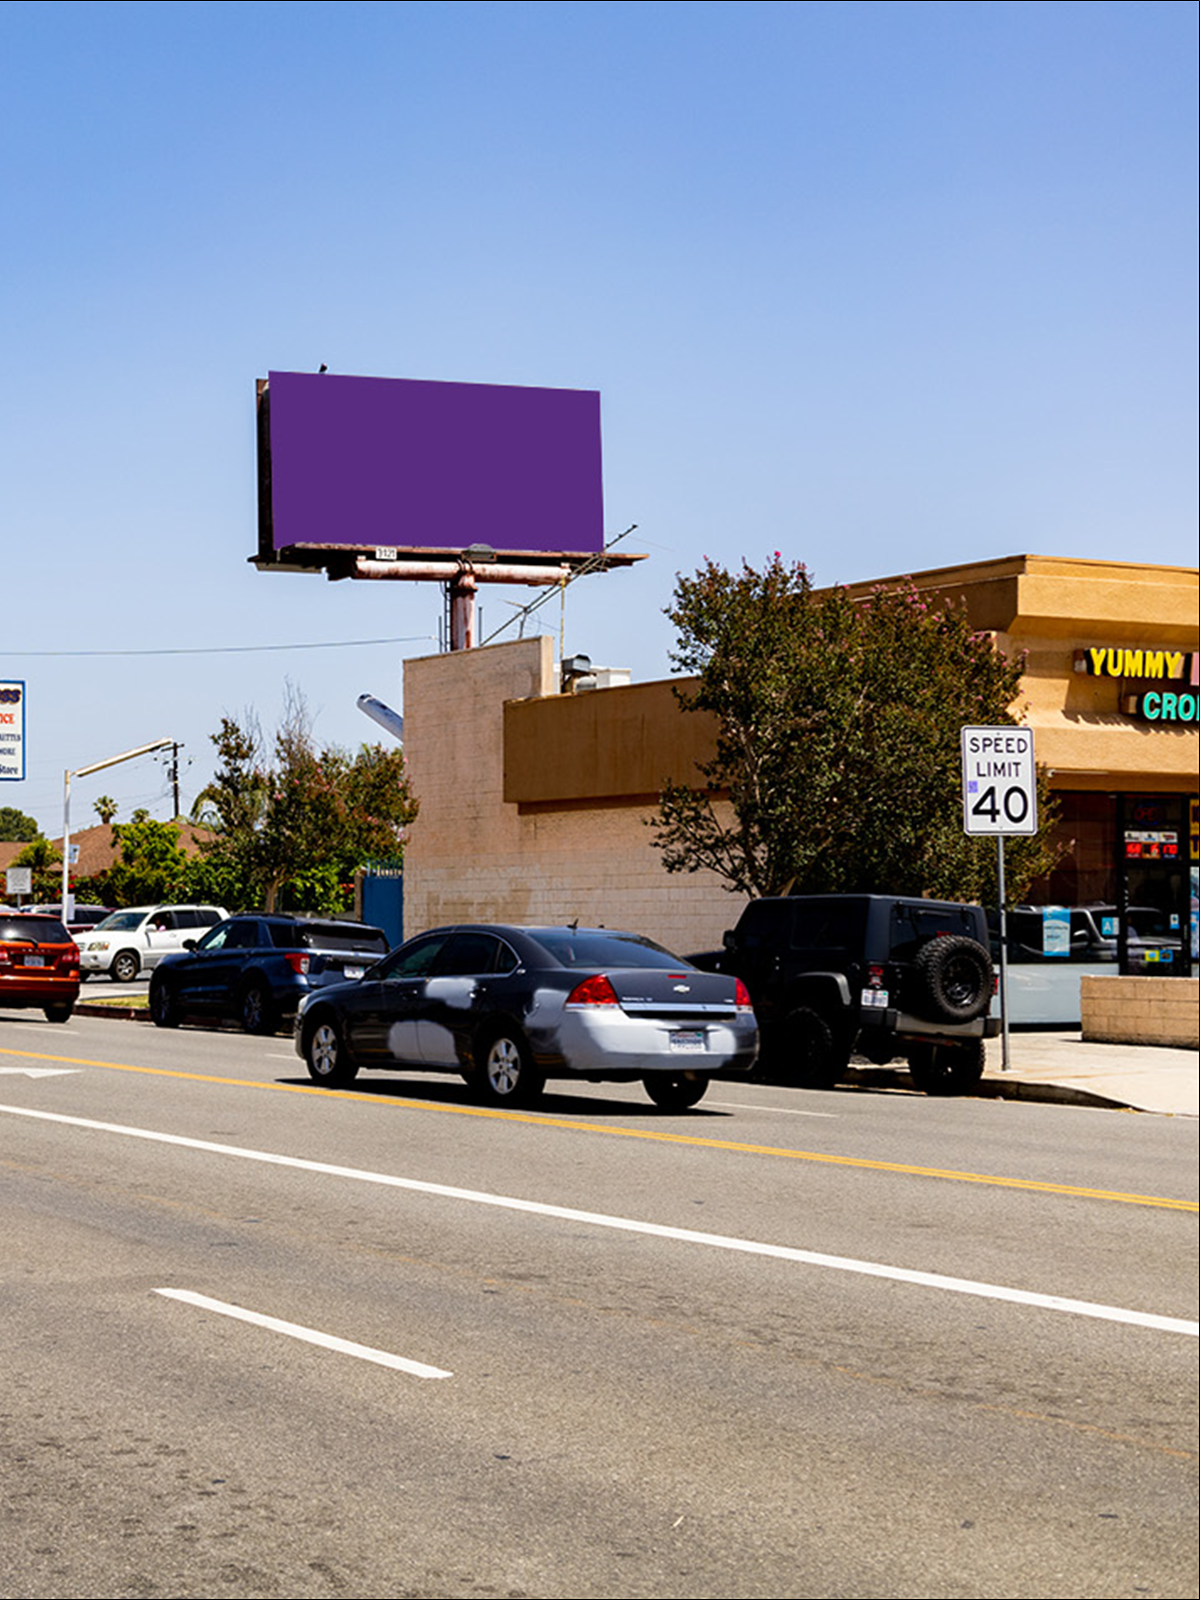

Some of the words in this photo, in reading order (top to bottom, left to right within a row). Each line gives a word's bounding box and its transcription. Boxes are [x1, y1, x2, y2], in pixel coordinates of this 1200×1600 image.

[1090, 647, 1181, 679] YUMMY
[969, 737, 1029, 753] SPEED
[976, 762, 1022, 777] LIMIT
[972, 786, 1029, 824] 40
